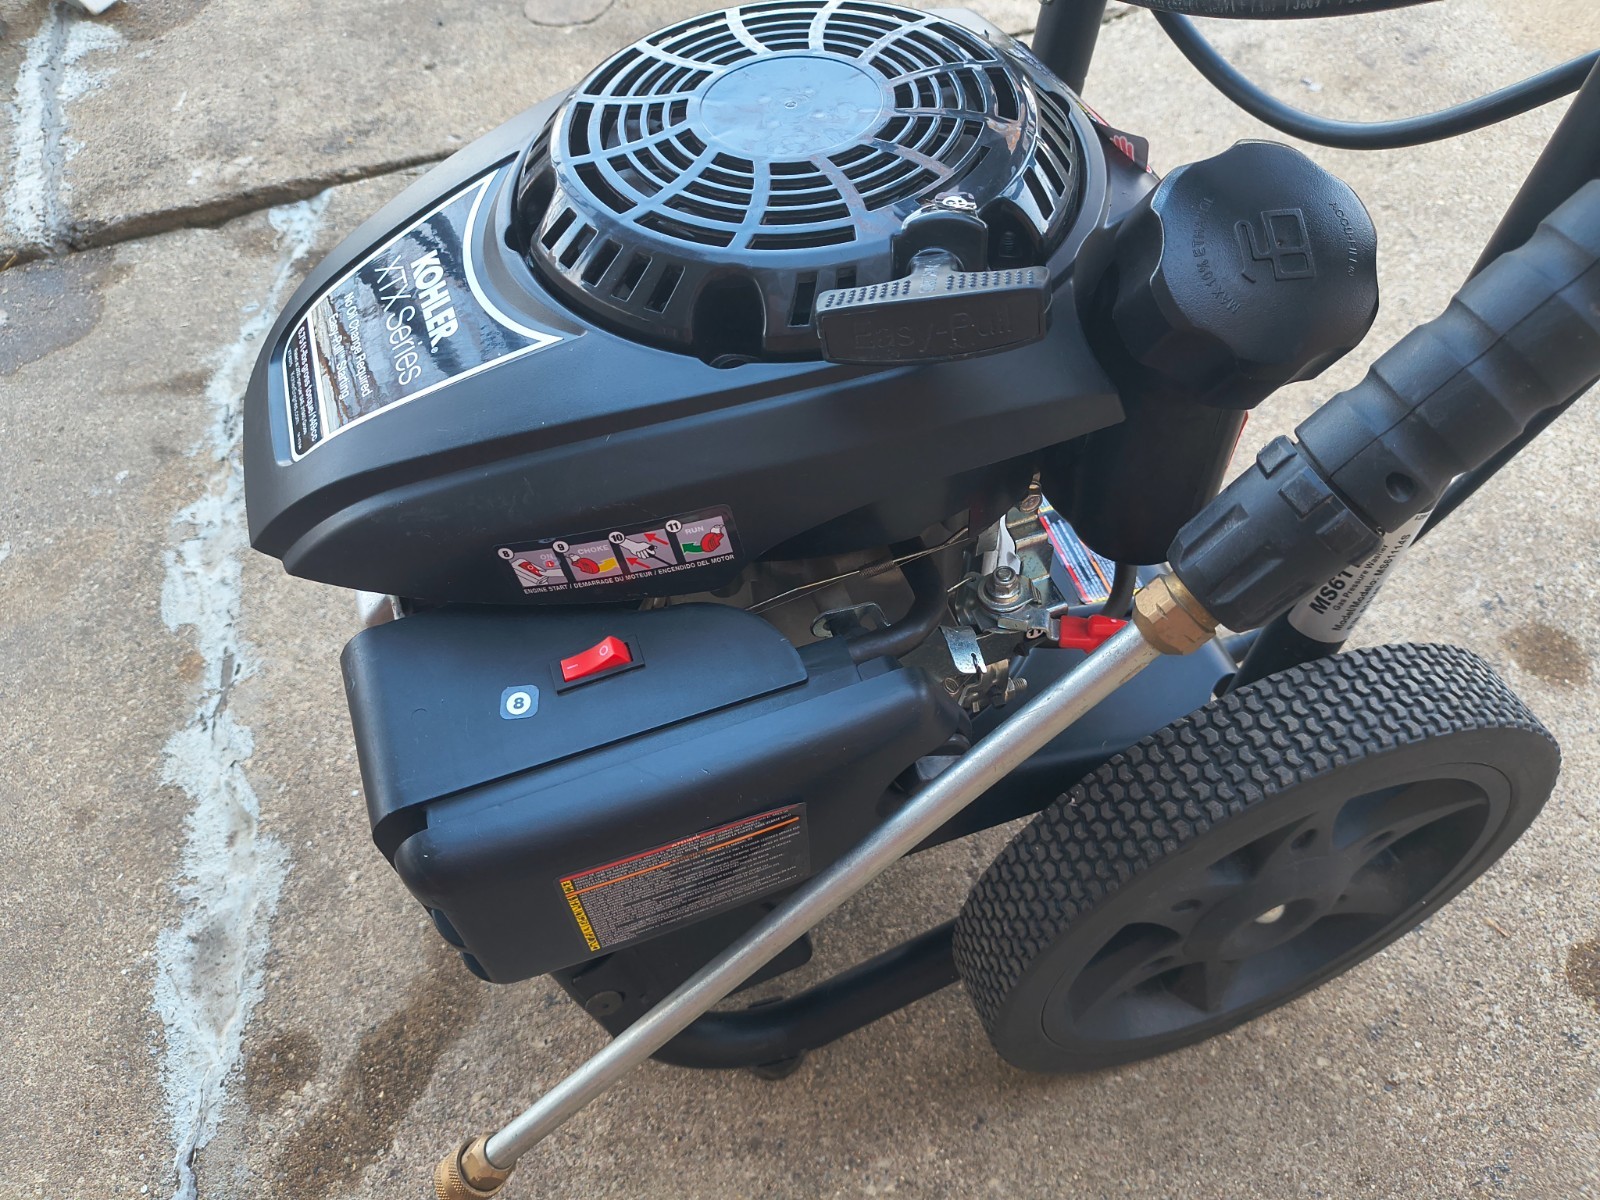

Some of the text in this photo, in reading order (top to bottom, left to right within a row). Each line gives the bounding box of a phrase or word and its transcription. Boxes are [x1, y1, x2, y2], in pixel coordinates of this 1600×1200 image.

[1196, 259, 1218, 288] 10%
[1212, 285, 1242, 315] MAX
[374, 254, 423, 386] XTX Series
[343, 291, 374, 398] No Oil Change Required
[301, 363, 311, 388] gross
[336, 359, 351, 400] Starting
[611, 533, 624, 543] 10
[667, 522, 680, 531] 11
[684, 526, 705, 535] RUN
[502, 550, 511, 559] 8
[557, 543, 566, 552] 9
[577, 544, 610, 555] CHOKE
[523, 585, 549, 595] ENGINE
[548, 582, 569, 592] START
[614, 574, 625, 583] DU
[625, 569, 653, 581] MOTEUR
[658, 560, 697, 575] ENCENDIDO
[696, 559, 711, 568] DEL
[711, 553, 736, 565] MOTOR
[1333, 599, 1347, 611] Gas
[1342, 569, 1369, 599] Pressure
[513, 697, 525, 710] 8
